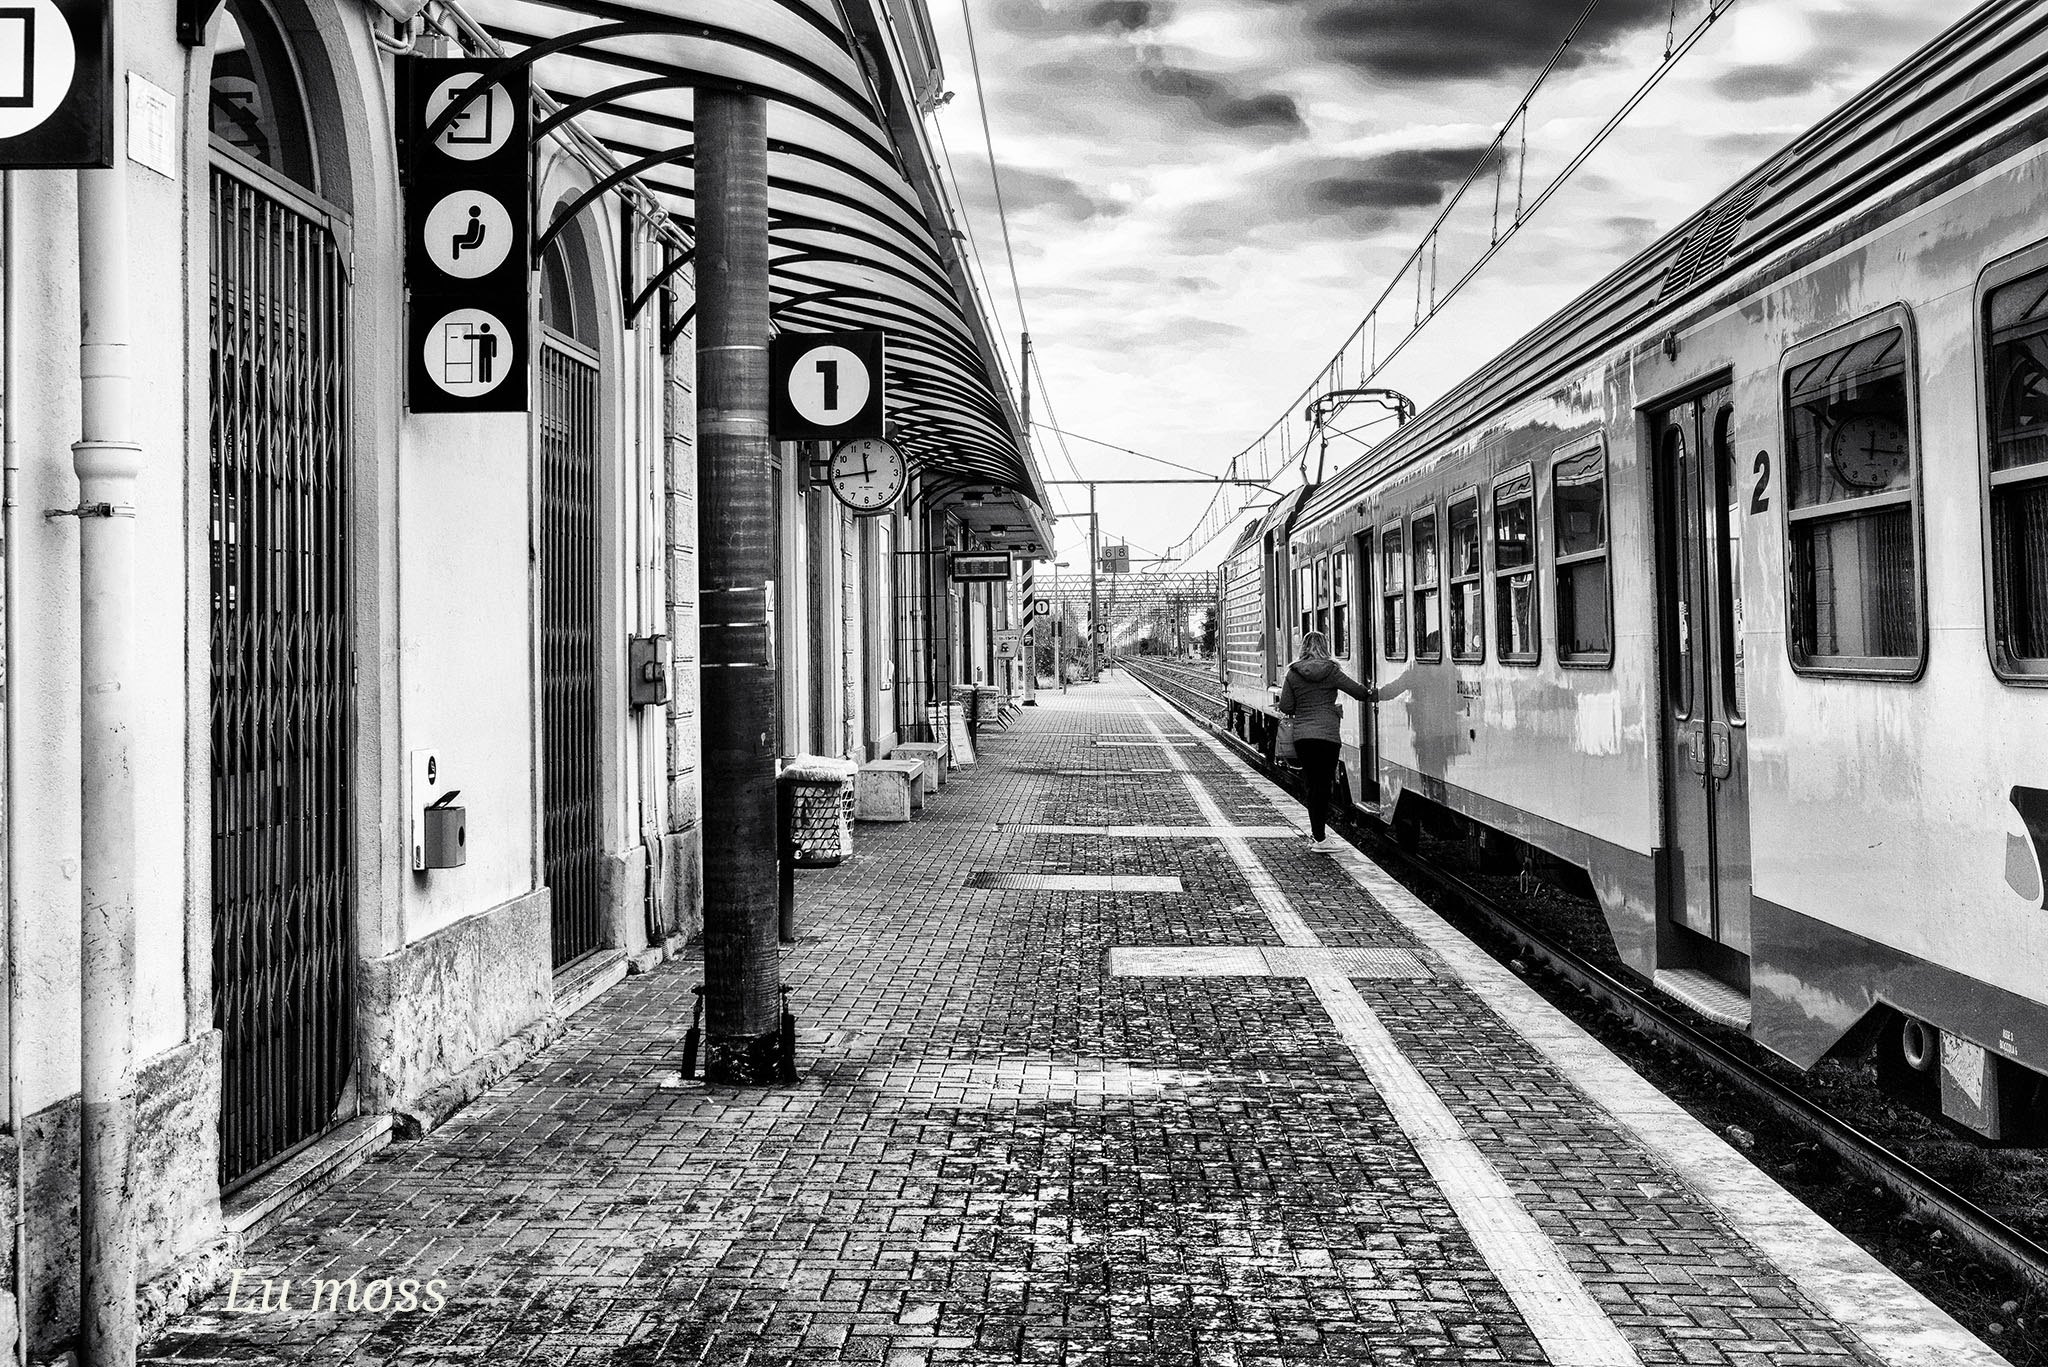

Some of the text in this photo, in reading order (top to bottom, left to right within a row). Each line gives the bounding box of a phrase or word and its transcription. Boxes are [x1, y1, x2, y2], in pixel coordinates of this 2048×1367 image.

[816, 360, 838, 410] 1
[850, 445, 857, 453] 11
[863, 441, 871, 449] 12
[840, 455, 847, 463] 10
[889, 455, 895, 463] 2
[839, 482, 845, 490] 8
[1750, 450, 1770, 515] 2
[850, 492, 856, 500] 7
[864, 496, 869, 504] 6
[878, 492, 883, 500] 5
[1105, 547, 1125, 558] 6 8
[1105, 561, 1113, 571] 4
